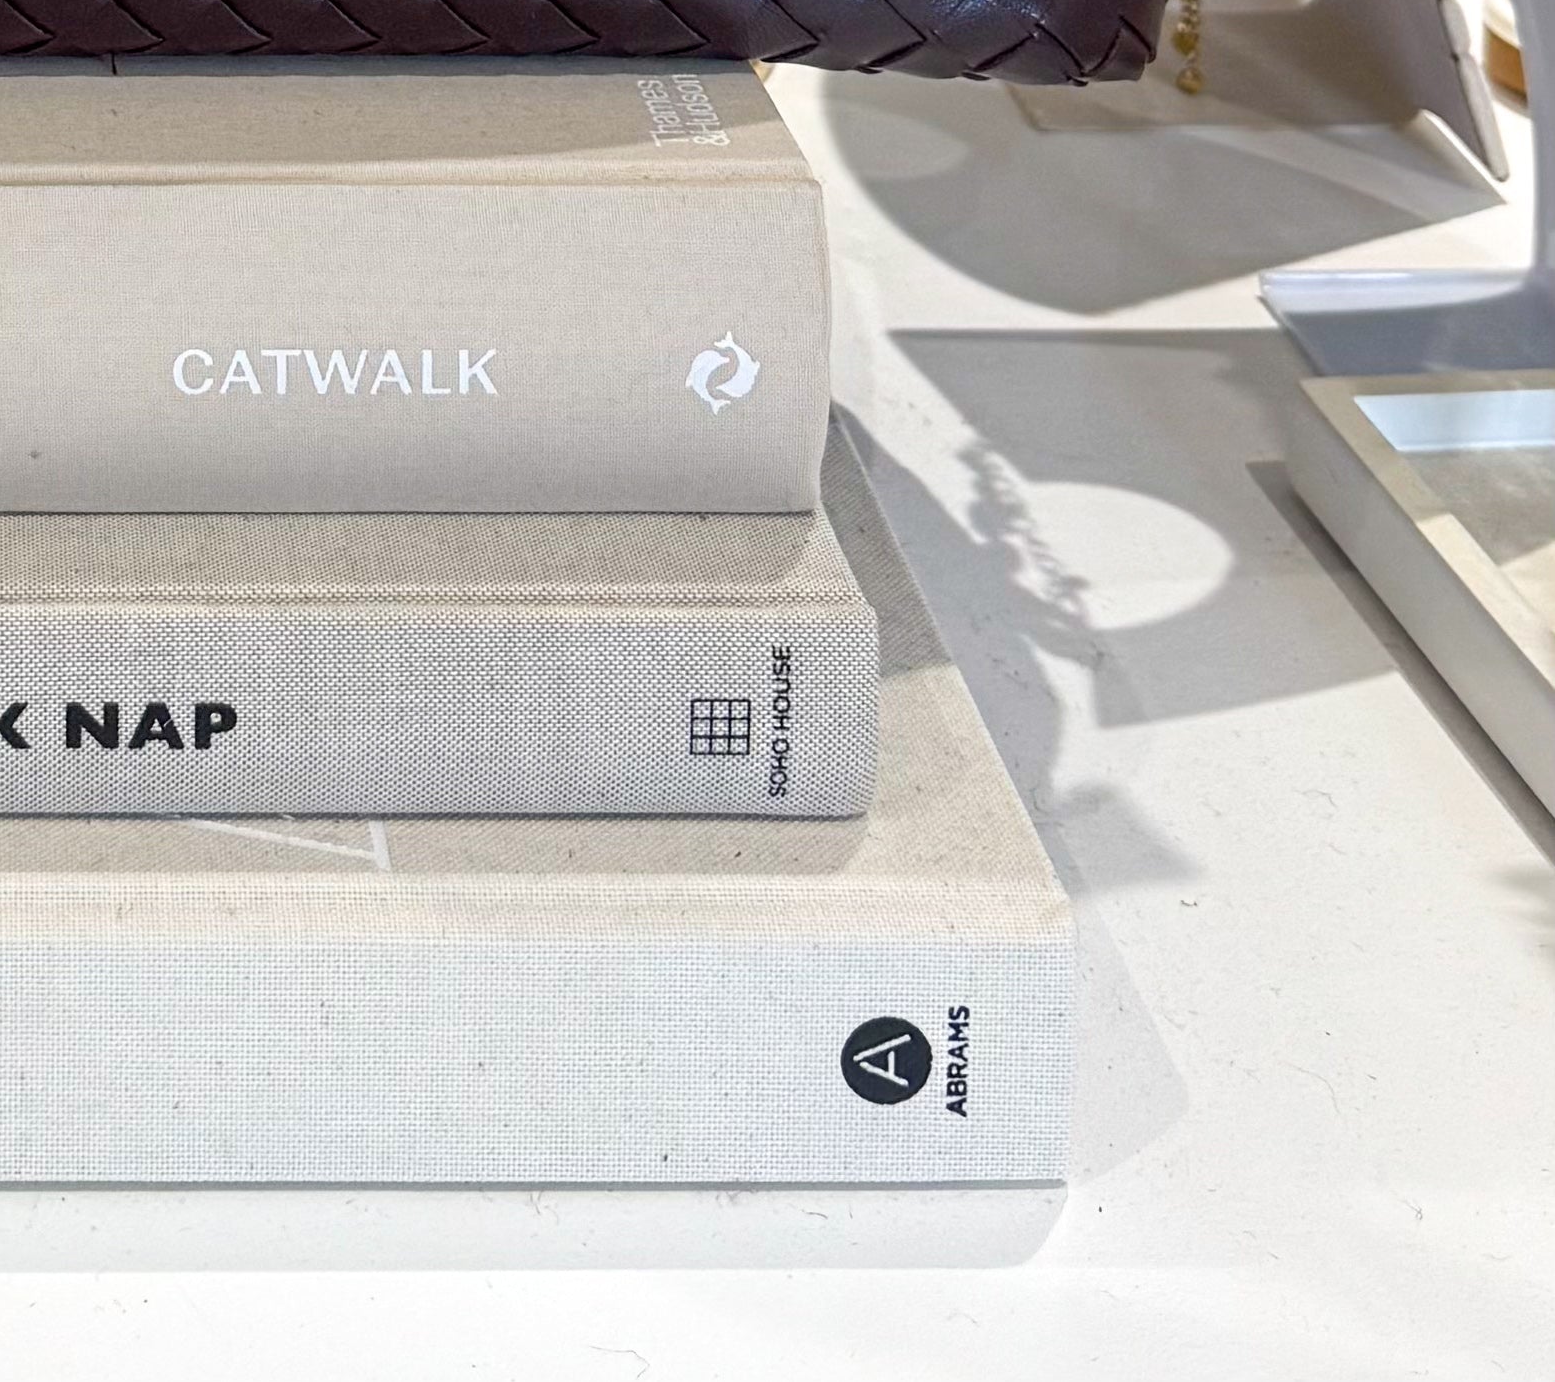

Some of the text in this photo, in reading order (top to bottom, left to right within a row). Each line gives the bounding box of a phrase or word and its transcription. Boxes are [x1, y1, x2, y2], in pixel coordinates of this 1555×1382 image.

[637, 79, 690, 147] Thames
[172, 347, 499, 396] CATWALK
[64, 701, 239, 751] NAP
[767, 644, 792, 798] SOHO HOUSE
[945, 1005, 971, 1119] ABRAMS
